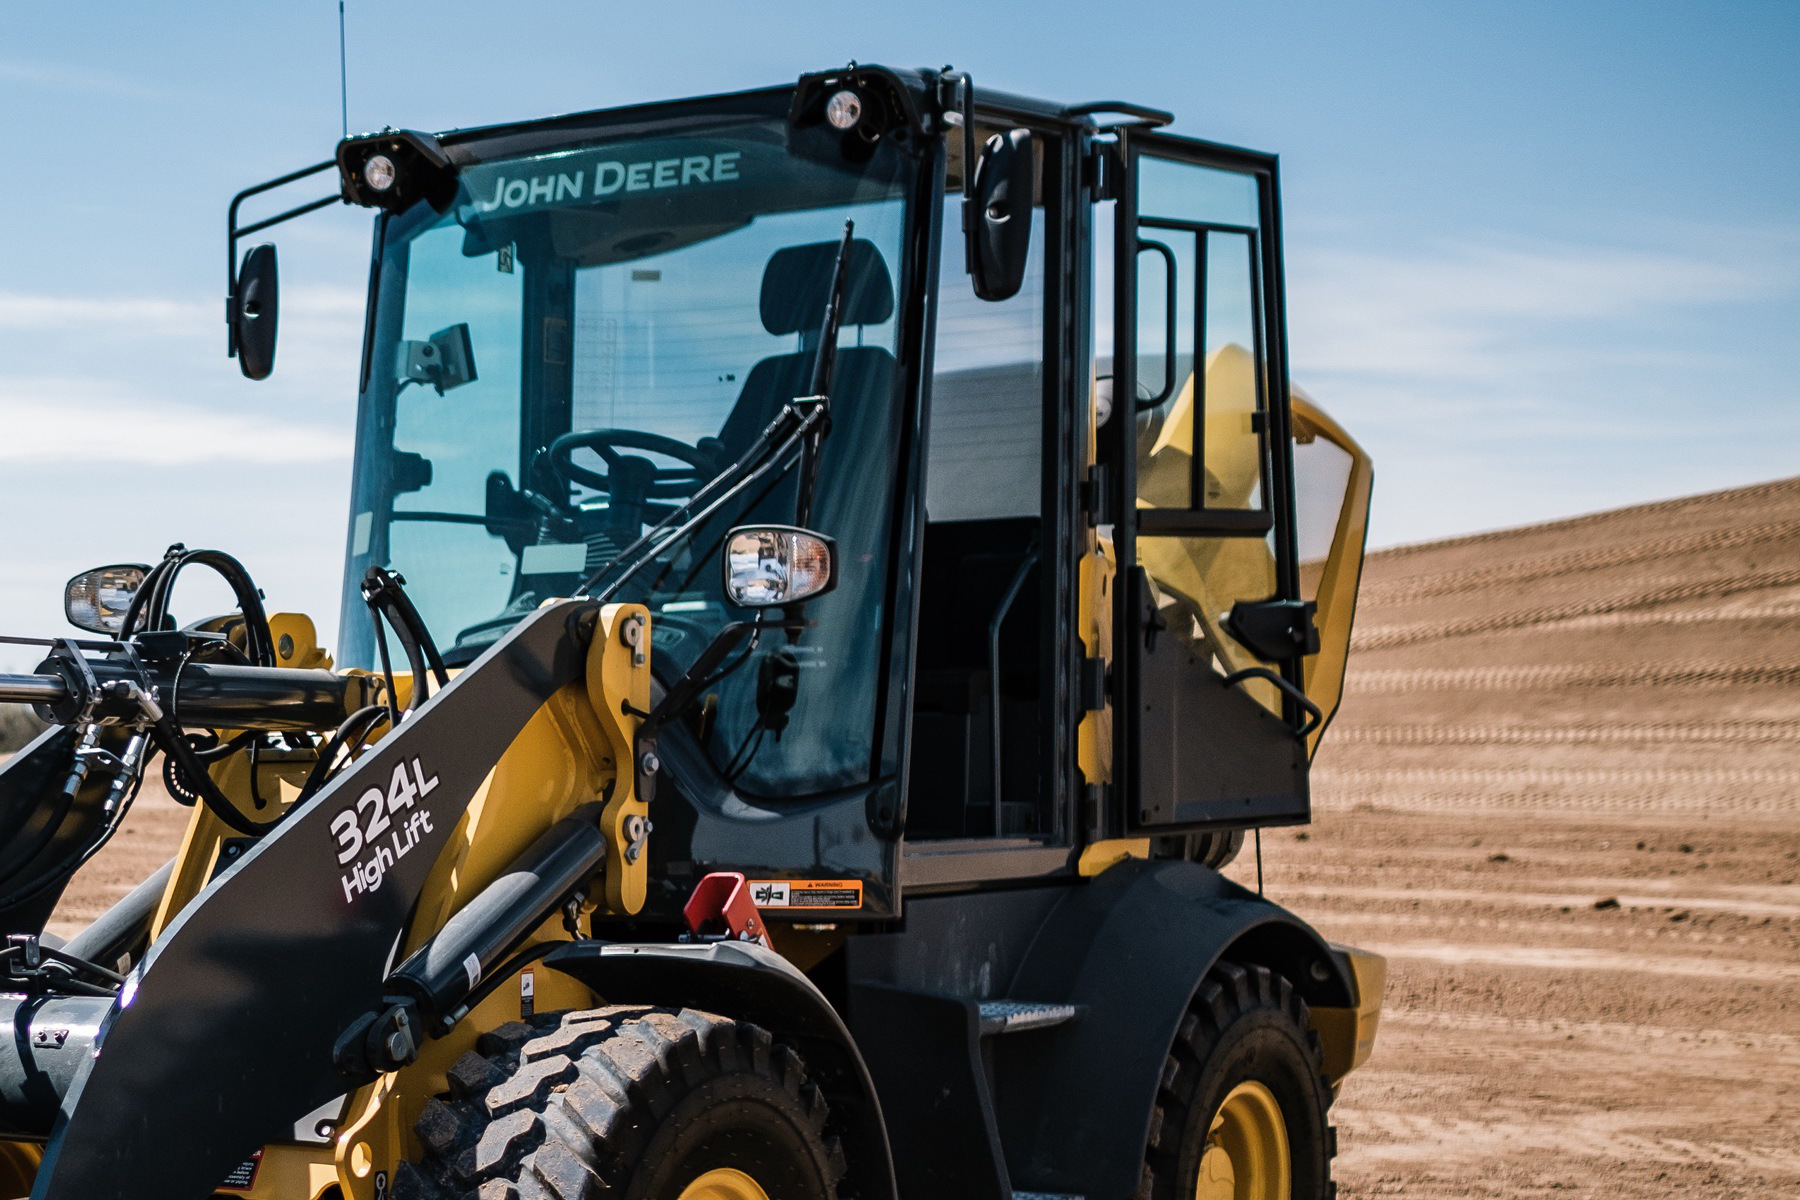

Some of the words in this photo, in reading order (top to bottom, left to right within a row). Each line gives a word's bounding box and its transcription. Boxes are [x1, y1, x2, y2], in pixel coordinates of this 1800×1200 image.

[482, 171, 585, 212] JOHN
[594, 151, 742, 196] DEERE
[329, 757, 440, 866] 324L
[341, 845, 394, 904] High
[391, 809, 434, 860] Lift
